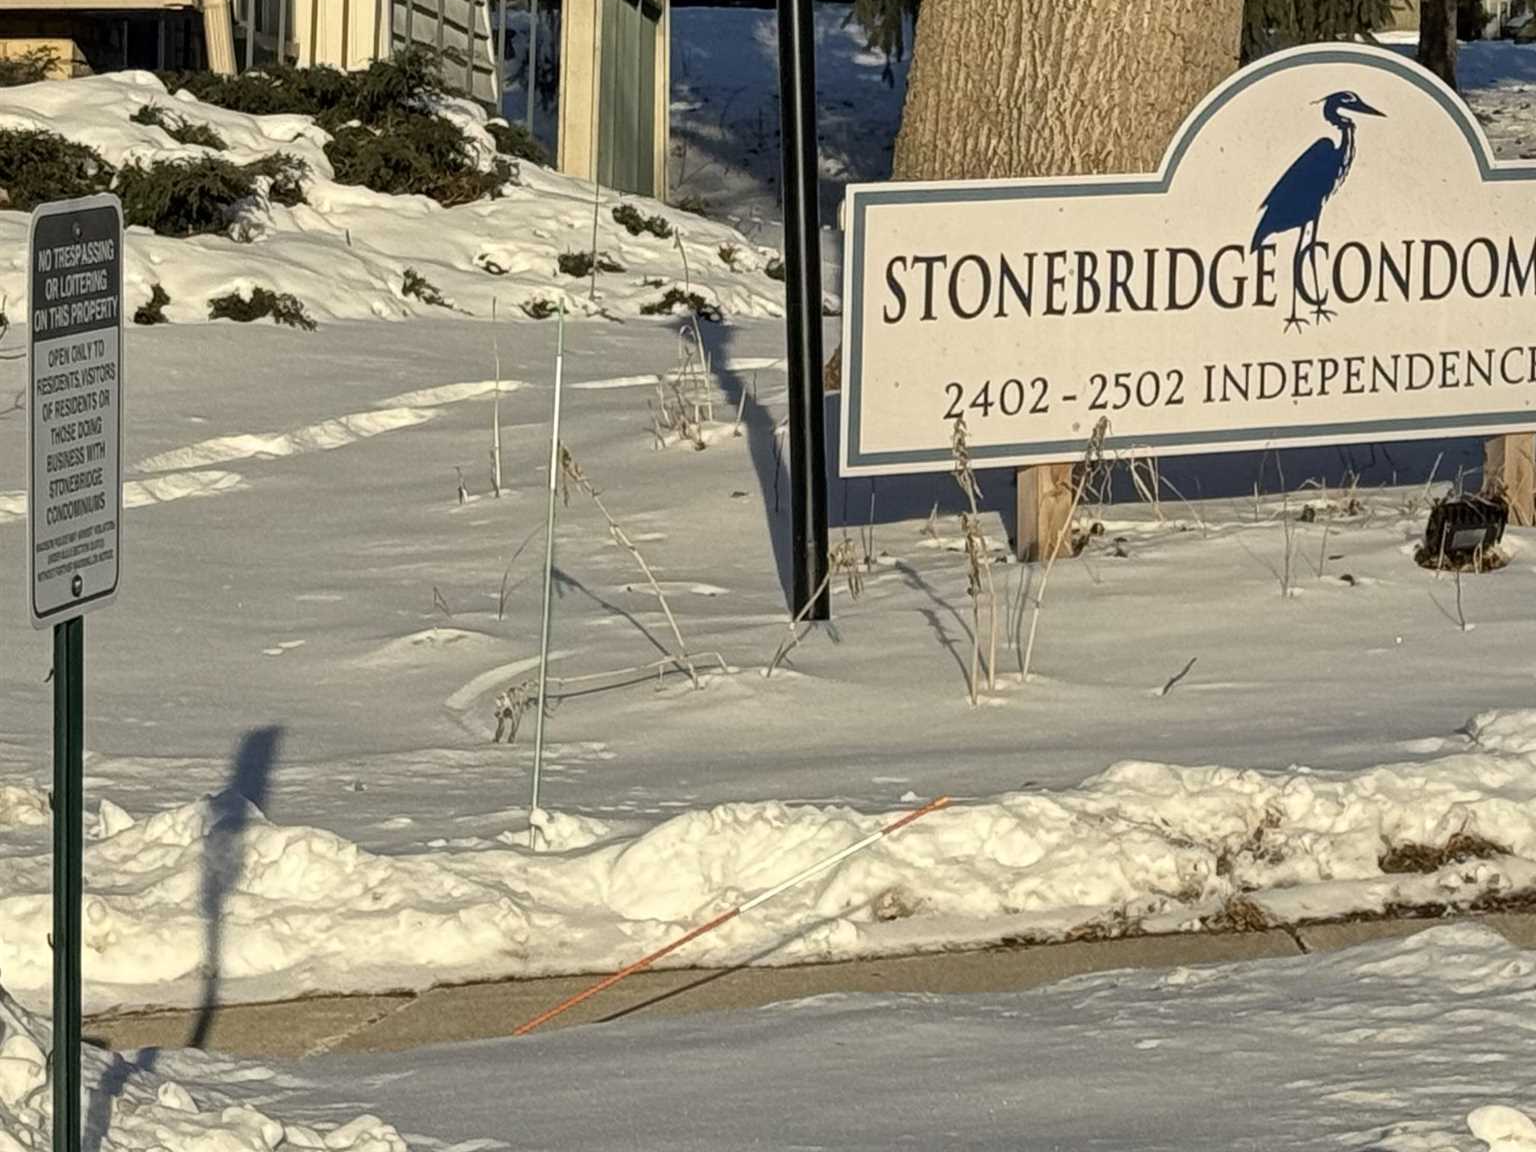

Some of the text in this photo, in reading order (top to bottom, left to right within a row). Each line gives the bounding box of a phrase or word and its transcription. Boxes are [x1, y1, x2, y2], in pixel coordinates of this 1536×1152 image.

[38, 239, 115, 272] NO TRESPASSING
[45, 269, 107, 301] OR LOITERING
[882, 244, 1278, 324] STONEBRIDGE
[34, 295, 118, 332] ON THIS PROPERTY
[48, 347, 70, 368] OPEN
[93, 339, 105, 358] TO
